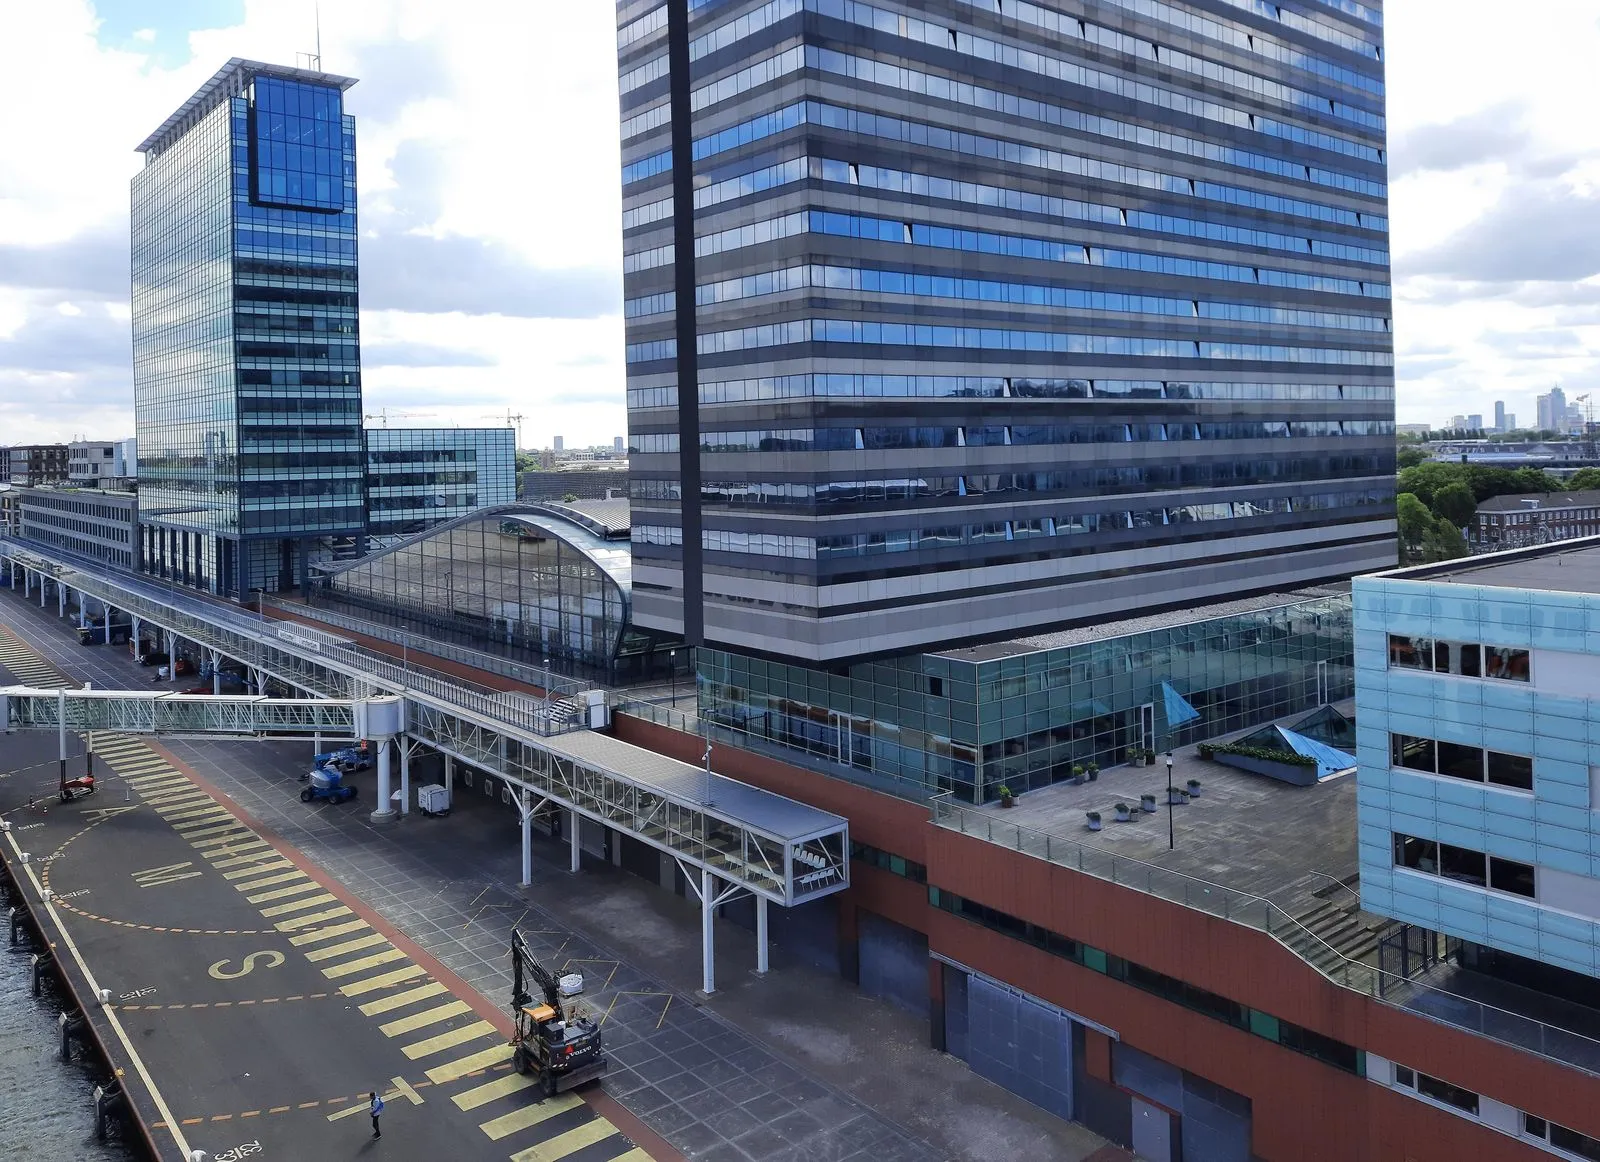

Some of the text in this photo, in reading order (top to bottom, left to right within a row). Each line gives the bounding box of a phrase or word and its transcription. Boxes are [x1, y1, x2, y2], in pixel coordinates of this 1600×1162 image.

[131, 861, 203, 888] M
[207, 950, 286, 980] S
[569, 1045, 592, 1057] VOLVO
[239, 1140, 263, 1156] 32
